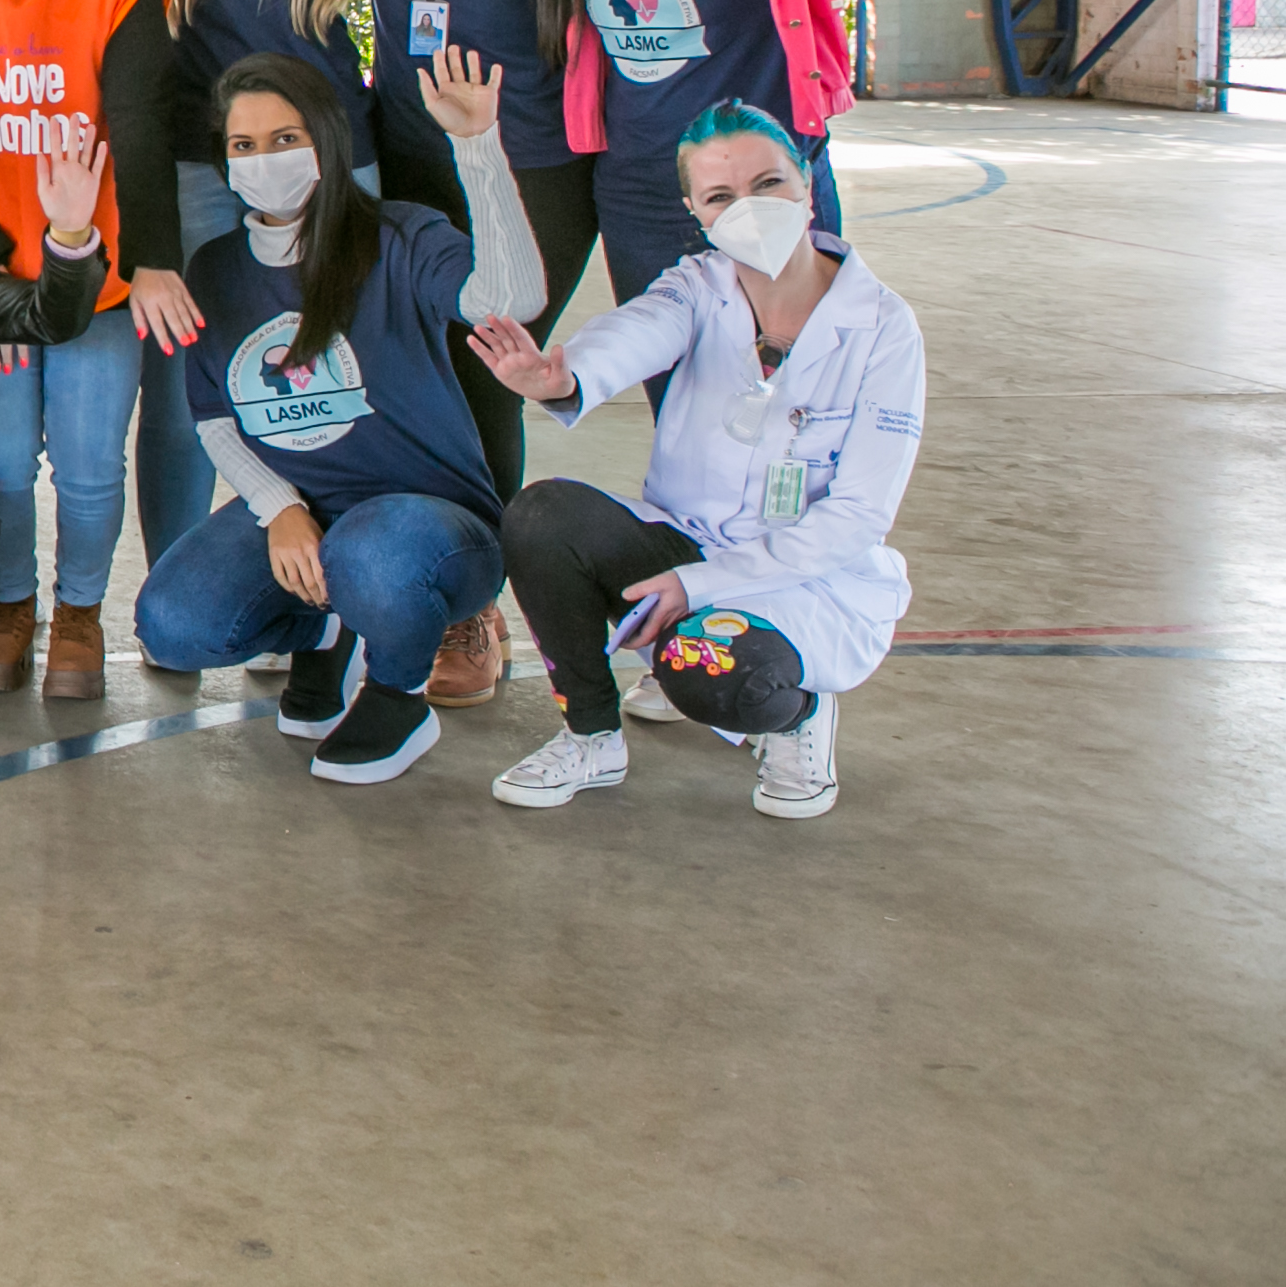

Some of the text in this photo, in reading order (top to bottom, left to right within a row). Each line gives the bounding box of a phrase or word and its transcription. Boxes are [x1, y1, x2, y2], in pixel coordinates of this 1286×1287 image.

[615, 35, 670, 52] LASMC
[265, 324, 277, 335] DE
[278, 316, 299, 328] SAÚD
[265, 400, 333, 424] LASMC
